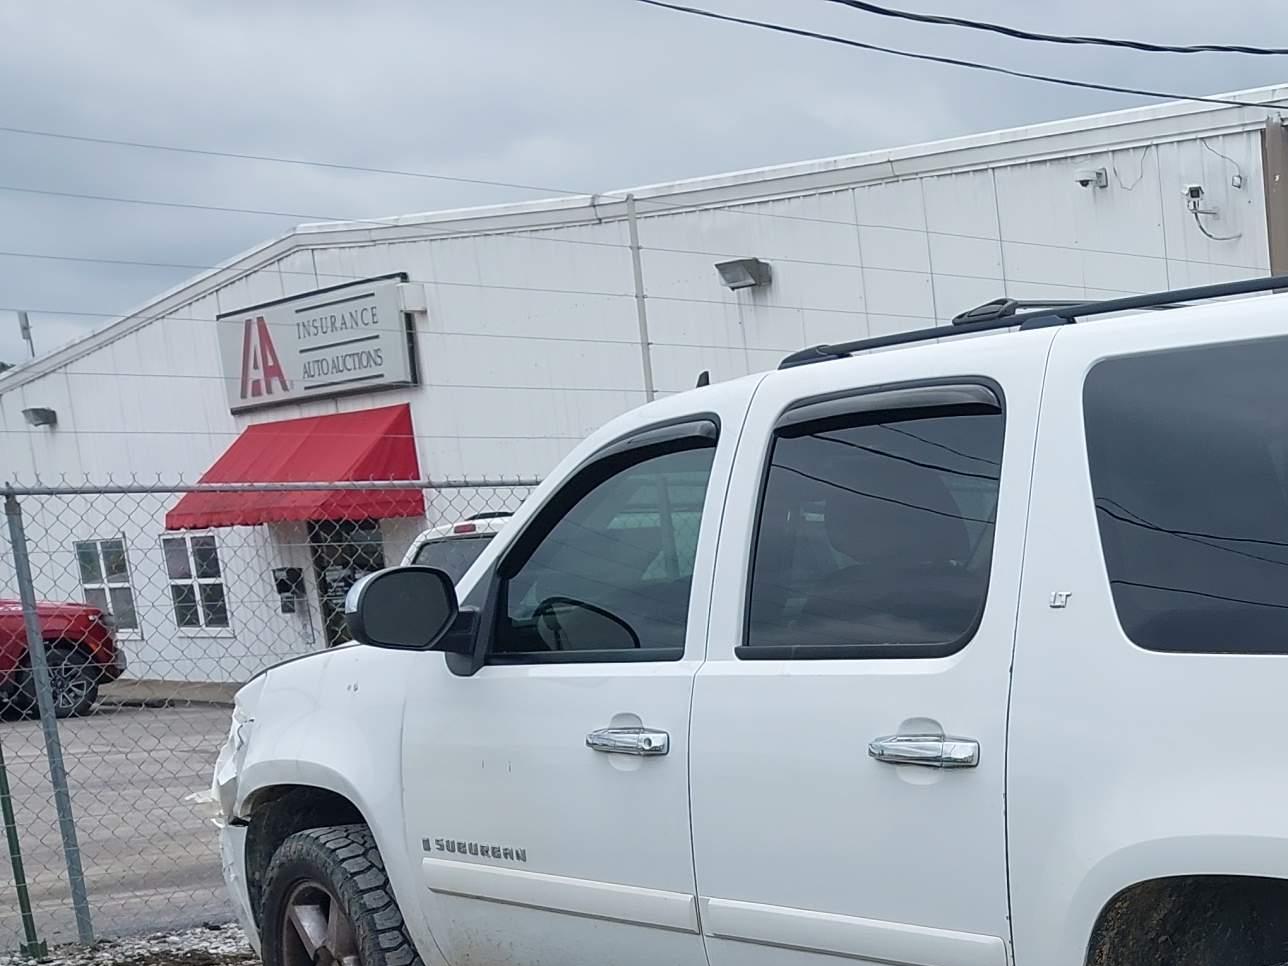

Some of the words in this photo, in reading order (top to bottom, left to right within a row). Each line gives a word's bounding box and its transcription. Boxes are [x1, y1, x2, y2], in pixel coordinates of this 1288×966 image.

[296, 306, 379, 340] INSURANCE
[302, 357, 330, 379] AUTO
[330, 348, 384, 375] AUCTIONS
[1049, 591, 1072, 608] LT
[434, 838, 527, 862] SUBURBAN
